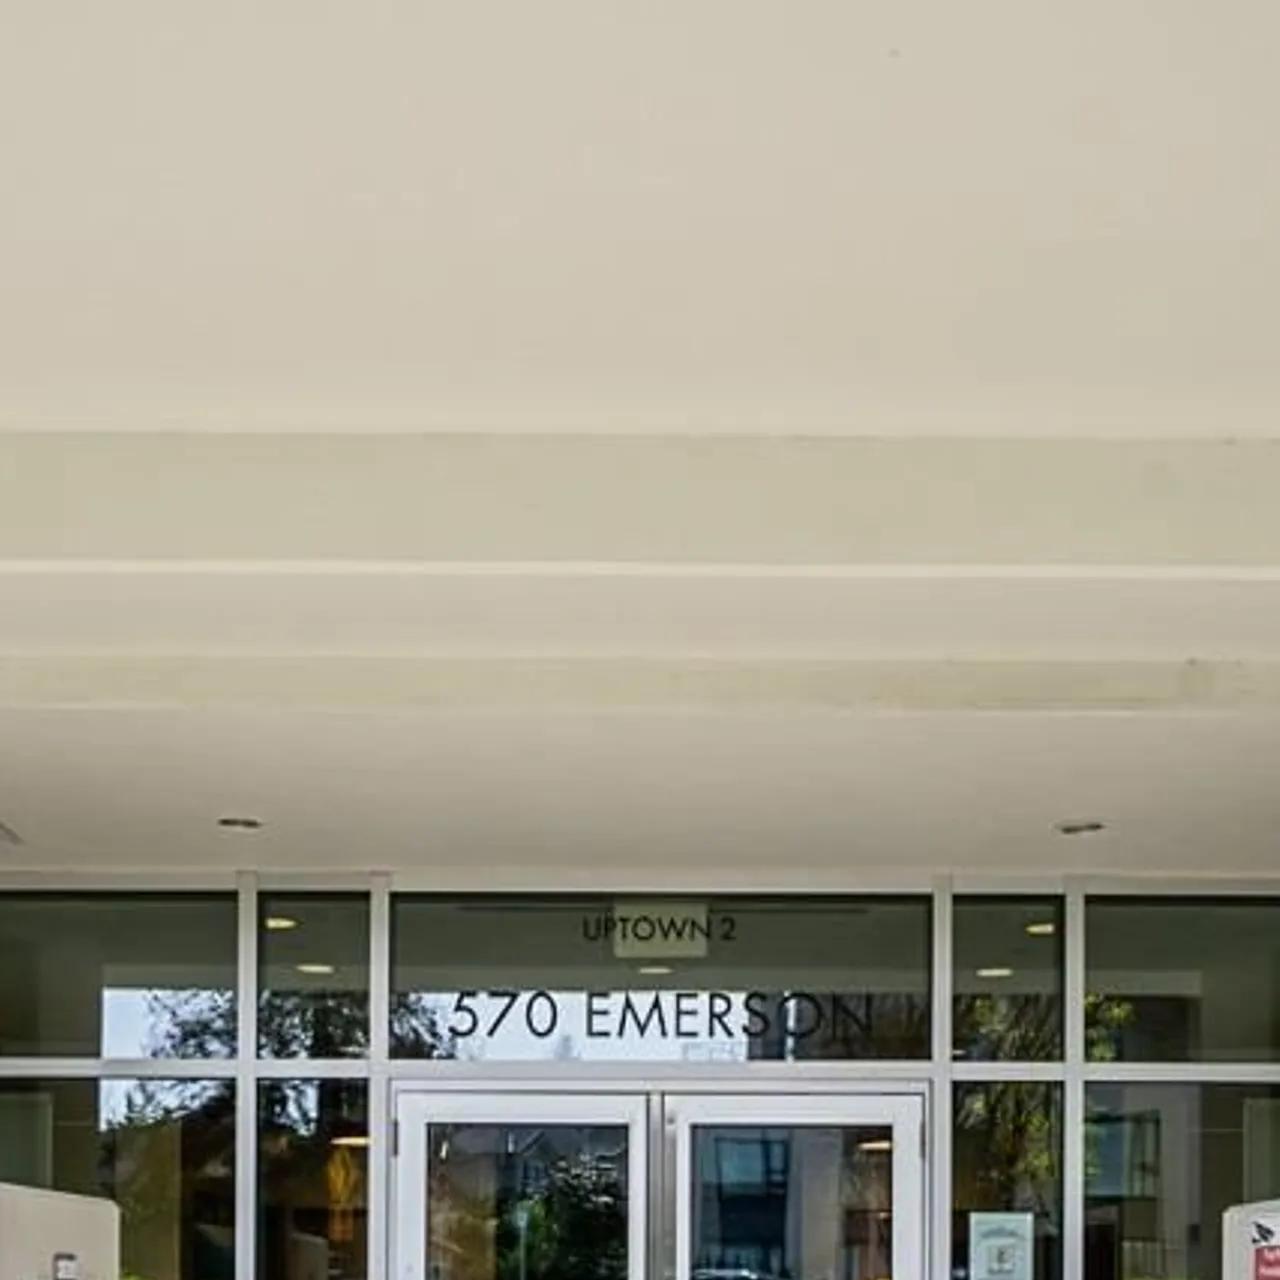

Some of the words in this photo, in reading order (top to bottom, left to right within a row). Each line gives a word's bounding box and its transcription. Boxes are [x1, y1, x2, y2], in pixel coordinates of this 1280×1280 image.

[582, 914, 712, 942] UPTOWN
[720, 915, 737, 941] 2
[447, 989, 558, 1038] 570
[585, 990, 871, 1039] EMERSON
